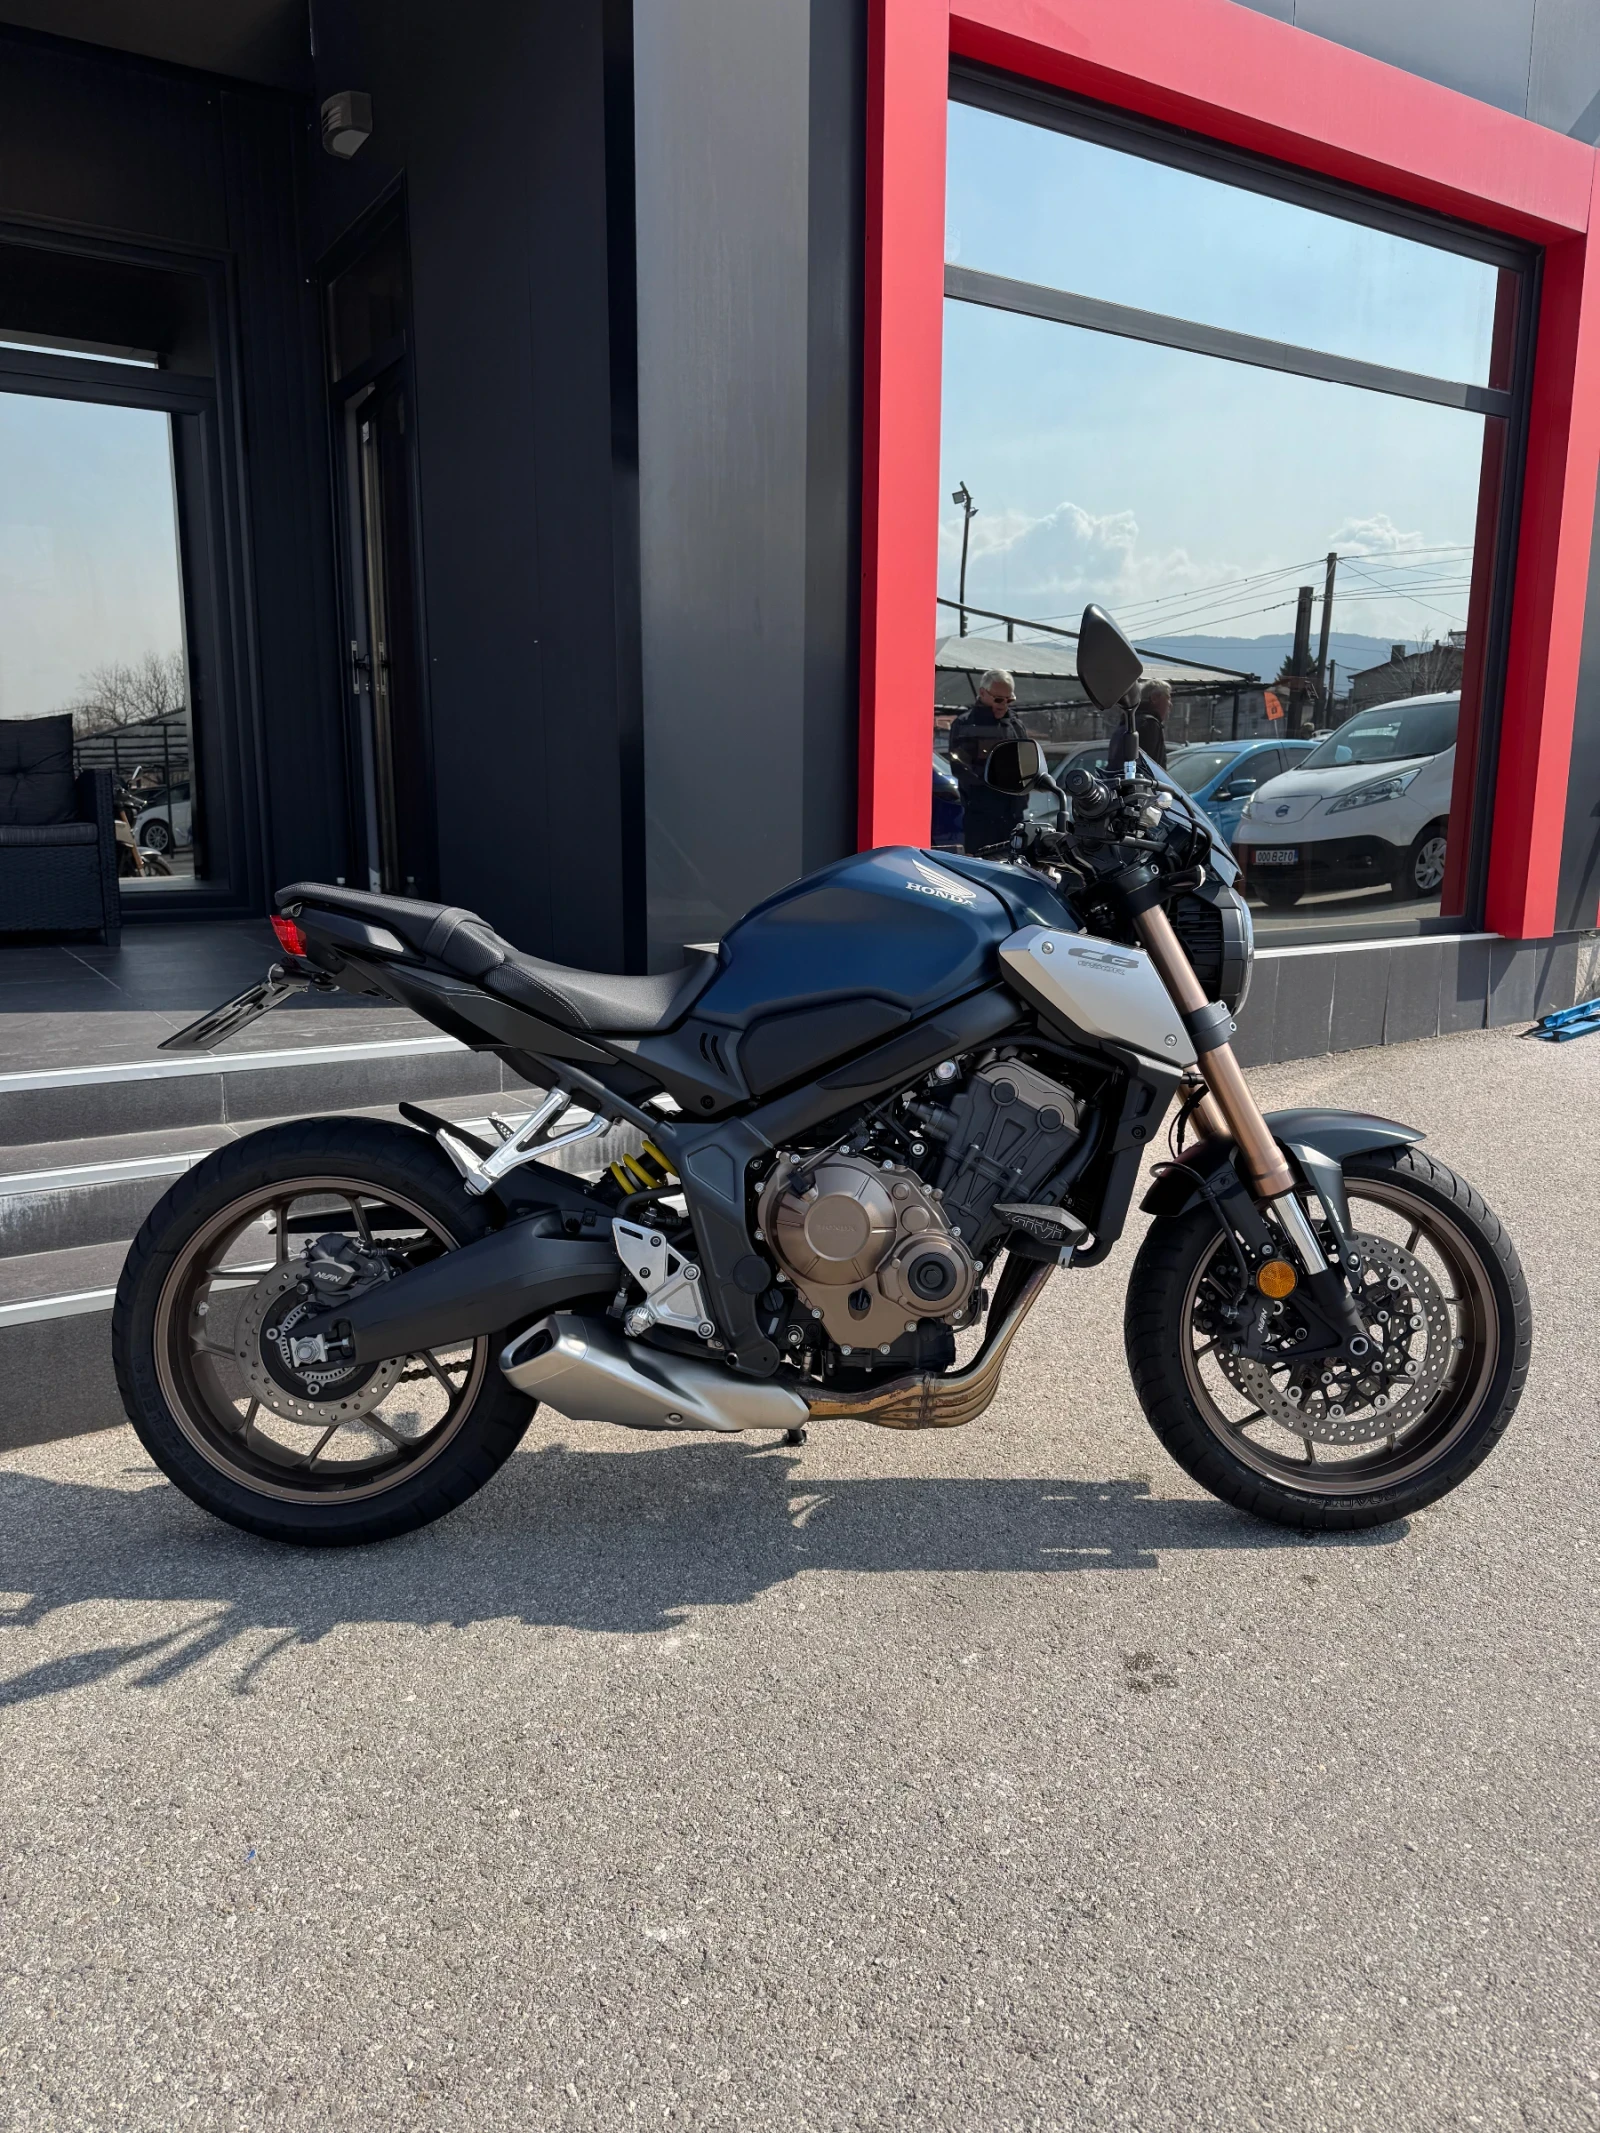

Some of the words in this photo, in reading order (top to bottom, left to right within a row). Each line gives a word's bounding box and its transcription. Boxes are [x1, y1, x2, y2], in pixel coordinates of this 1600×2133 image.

[905, 881, 977, 910] HONDA
[1068, 948, 1139, 968] CB
[815, 1224, 857, 1233] HONDA
